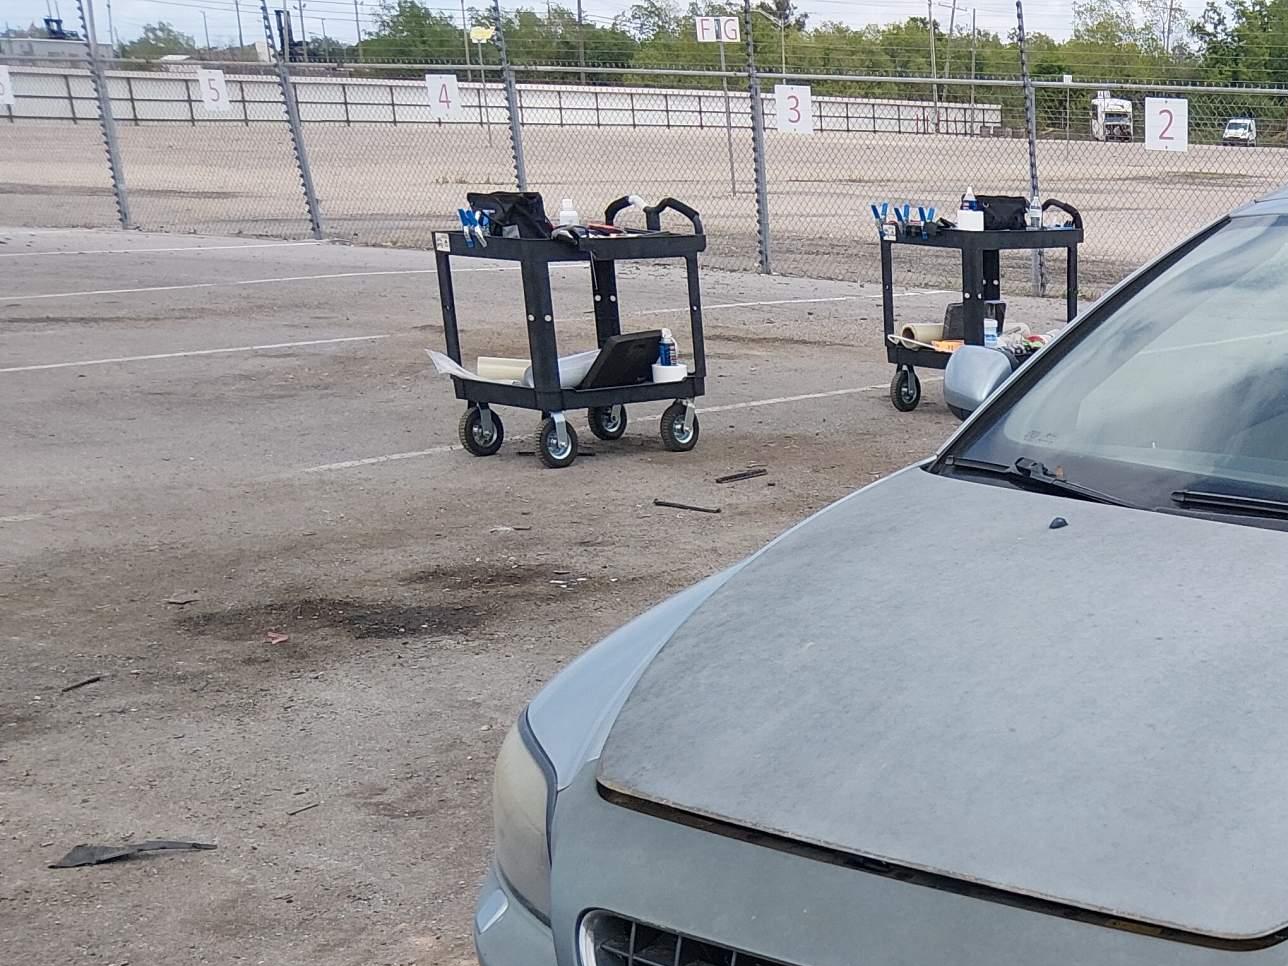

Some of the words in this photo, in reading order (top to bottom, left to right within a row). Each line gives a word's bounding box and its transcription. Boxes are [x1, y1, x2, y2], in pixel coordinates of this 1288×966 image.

[700, 18, 710, 40] F
[723, 18, 738, 40] G
[207, 78, 220, 102] 5
[438, 83, 451, 109] 4
[787, 95, 801, 124] 3
[1159, 109, 1174, 140] 2
